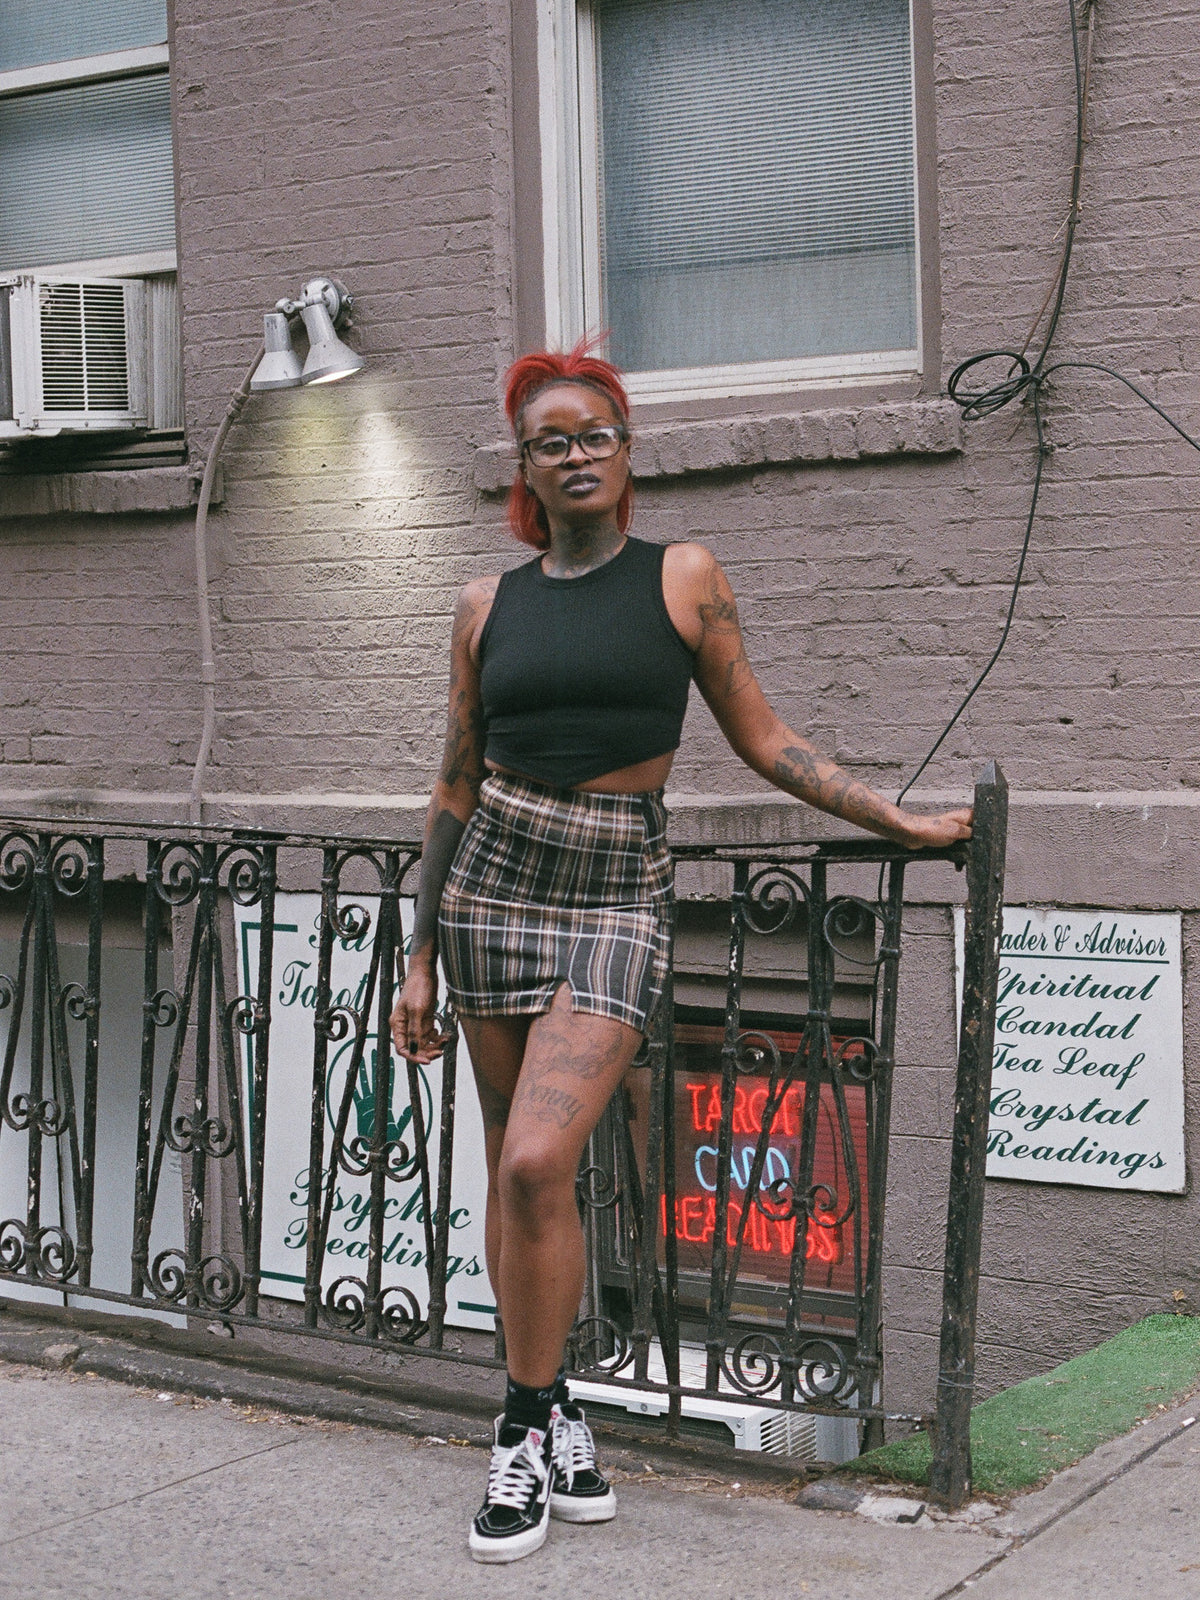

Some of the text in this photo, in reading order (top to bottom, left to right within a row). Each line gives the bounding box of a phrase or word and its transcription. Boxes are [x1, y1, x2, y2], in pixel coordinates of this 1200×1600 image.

[999, 919, 1168, 957] ader & Advisor
[278, 960, 369, 1012] Taot
[994, 1005, 1142, 1040] Candal
[991, 1042, 1146, 1090] Tea Leaf
[989, 1087, 1150, 1132] Crystal
[986, 1129, 1167, 1179] Readings
[290, 1167, 472, 1232] Psychc
